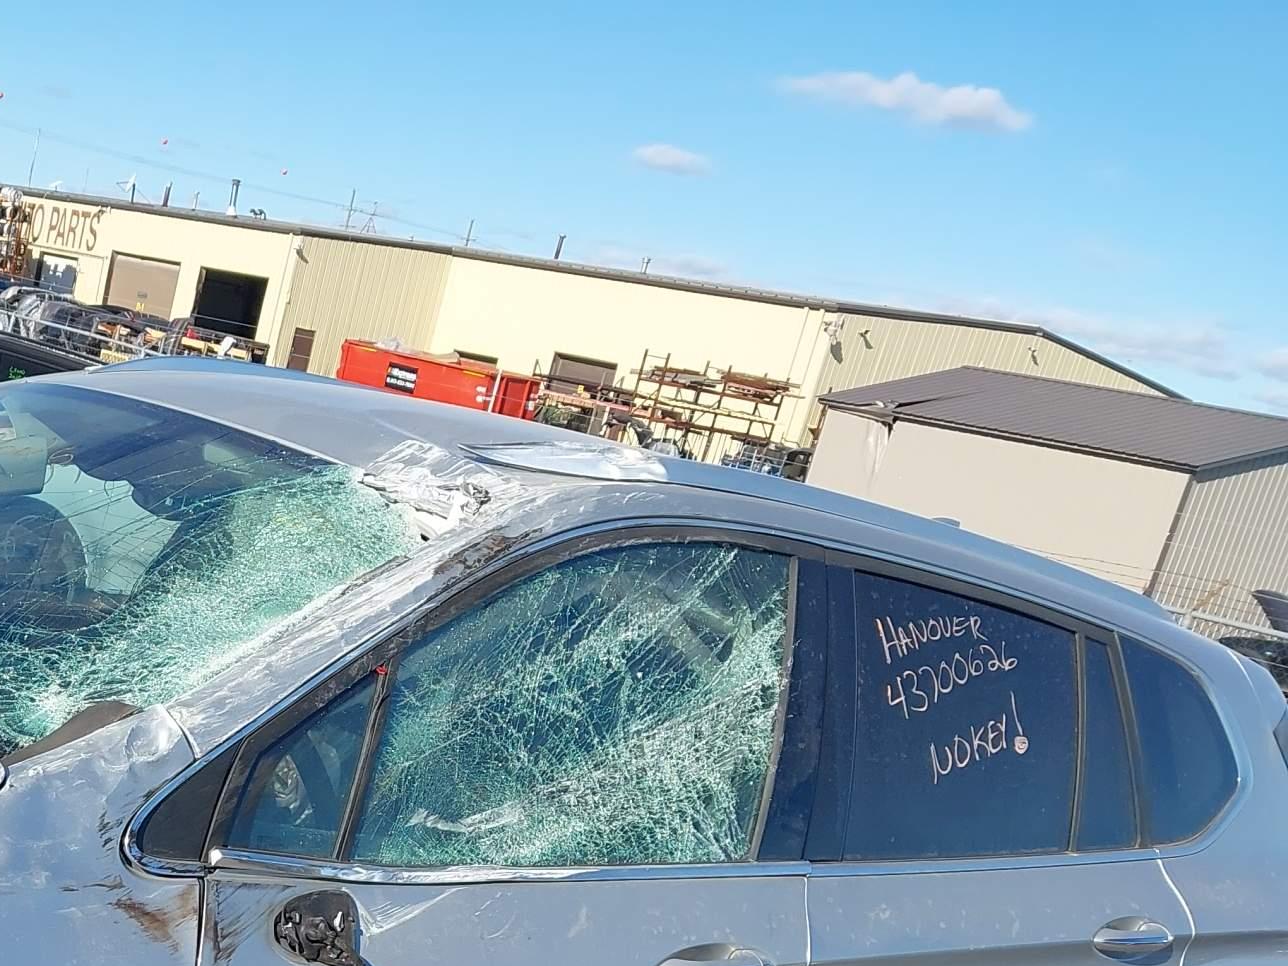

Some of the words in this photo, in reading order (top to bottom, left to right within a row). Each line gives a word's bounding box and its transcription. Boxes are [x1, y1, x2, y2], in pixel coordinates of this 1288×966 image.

[46, 206, 101, 251] PARTS
[876, 616, 988, 664] HANOVER
[887, 641, 1018, 720] 43700626
